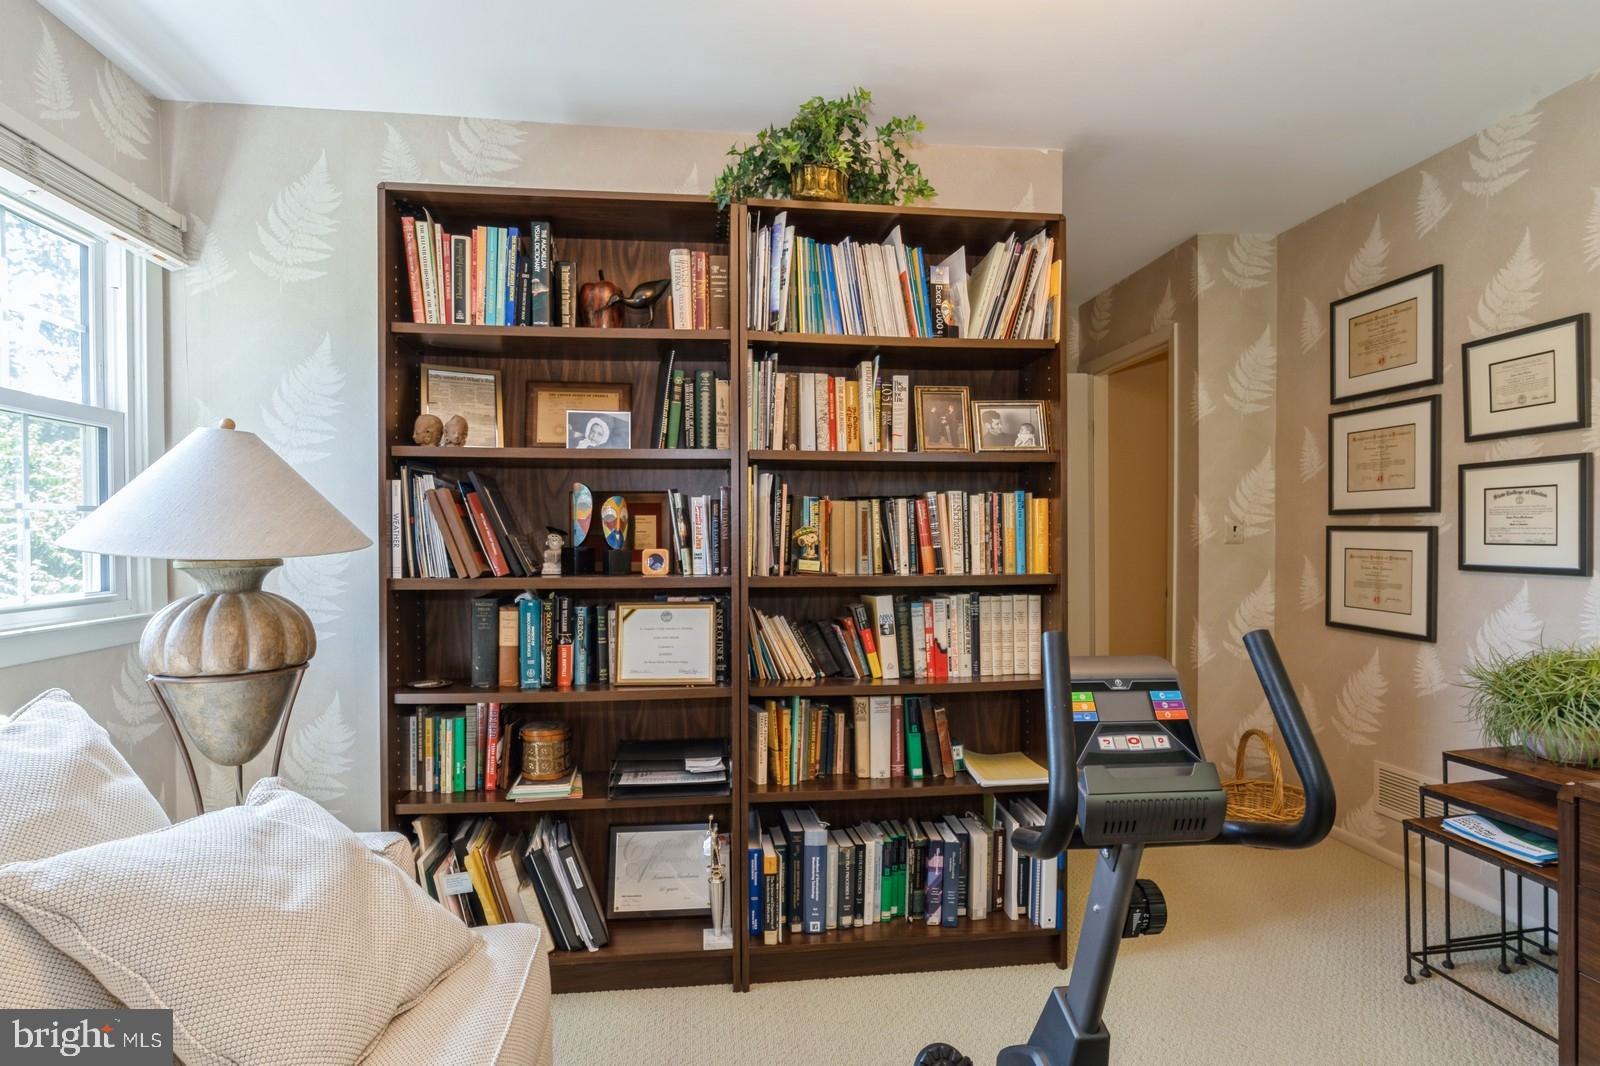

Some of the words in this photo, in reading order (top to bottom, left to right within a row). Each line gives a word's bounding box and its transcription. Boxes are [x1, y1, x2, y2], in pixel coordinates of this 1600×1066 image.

[935, 284, 943, 305] Excel
[935, 307, 943, 329] 2000
[881, 383, 893, 406] LOST
[952, 504, 962, 552] Shcharansky
